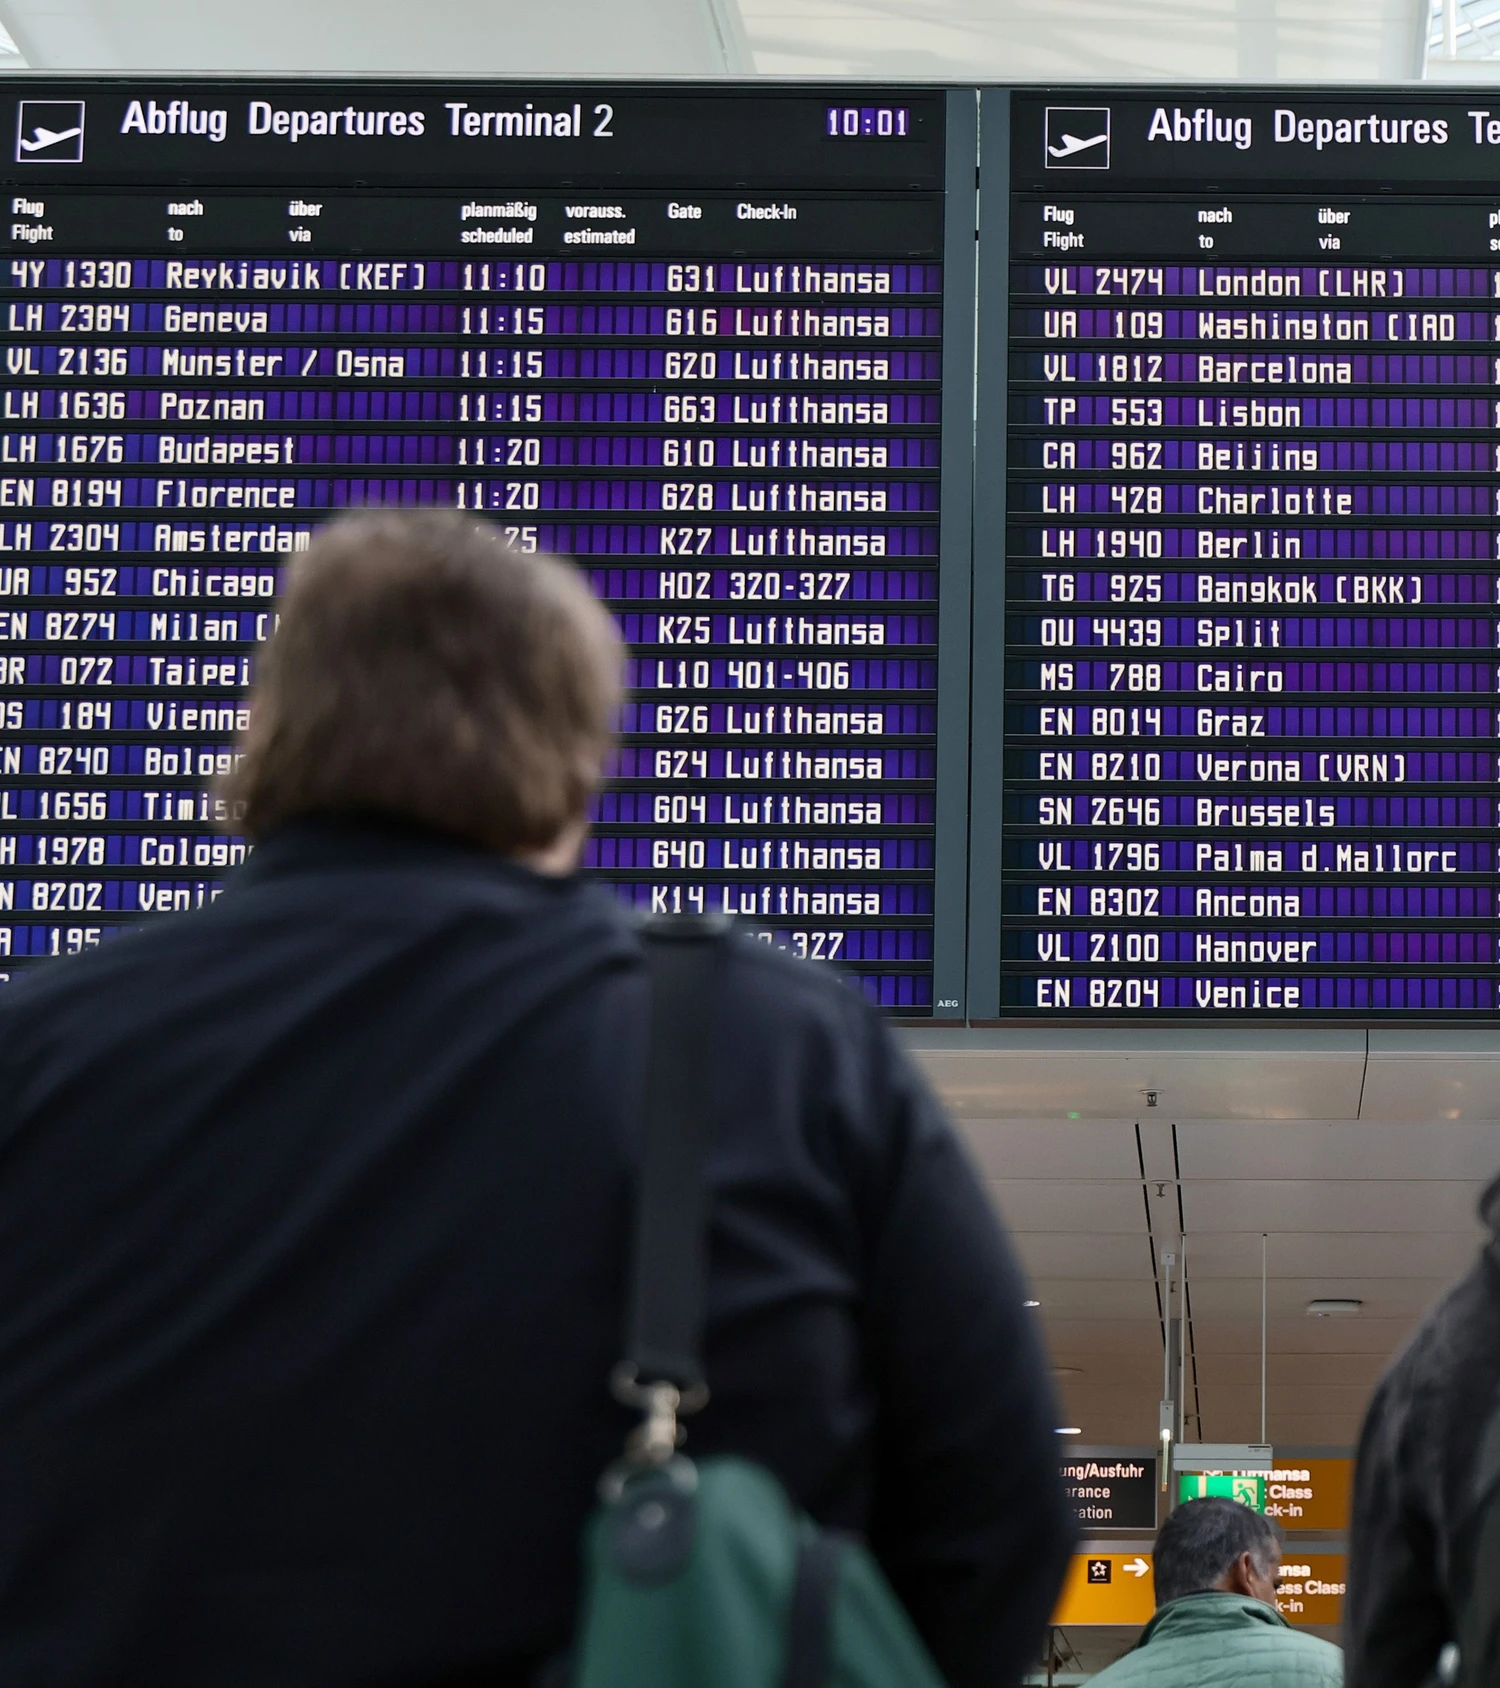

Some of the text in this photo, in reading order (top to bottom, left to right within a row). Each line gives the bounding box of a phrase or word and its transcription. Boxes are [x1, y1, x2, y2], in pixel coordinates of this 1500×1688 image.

[121, 100, 613, 143] Abflug Departures Terminal 2
[830, 109, 906, 136] 10:01
[1148, 107, 1252, 150] Abflug
[1274, 109, 1448, 151] Departures
[12, 197, 797, 222] Flug nach über planmäßig vorauss. Gate Check-In
[1043, 205, 1074, 226] Flug
[1198, 206, 1233, 223] nach
[1318, 207, 1350, 224] über
[12, 223, 636, 245] Flight to via scheduled estimated
[1043, 231, 1084, 251] Flight
[1198, 234, 1214, 249] to
[1318, 233, 1341, 250] via
[9, 304, 43, 332] LH
[61, 304, 130, 332] 2384
[165, 305, 268, 333] Geneva
[462, 307, 544, 335] 11:15
[736, 309, 889, 337] Lufthansa
[1044, 354, 1076, 382] VL
[1098, 355, 1162, 383] 1812
[1198, 355, 1351, 384] Barcelona
[4, 391, 39, 419] LH
[59, 391, 125, 420] 1636
[161, 392, 264, 421] Poznan
[460, 394, 542, 422] 11:15
[734, 396, 888, 424] Lufthansa
[2, 435, 36, 463] LH
[57, 435, 123, 463] 1676
[159, 436, 294, 464] Budapest
[459, 438, 540, 466] 11:20
[733, 440, 887, 468] Lufthansa
[1043, 442, 1076, 470] CA
[1112, 442, 1162, 470] 962
[1198, 442, 1318, 471] Beijing
[0, 479, 34, 507] EN
[52, 479, 122, 508] 8194
[157, 480, 295, 509] Florence
[457, 482, 539, 510] 11:20
[732, 483, 887, 512] Lufthansa
[1042, 485, 1075, 514] LH
[1111, 486, 1162, 514] 428
[1198, 486, 1352, 515] Charlotte
[65, 568, 851, 601] 952 Chicago H02 320-327
[1041, 618, 1074, 647] OU
[1093, 618, 1161, 647] 4439
[1197, 619, 1280, 648] Split
[61, 657, 849, 690] 072 Taipei L10 401-406
[1040, 707, 1073, 736] EN
[1092, 708, 1161, 736] 8014
[1197, 708, 1265, 737] Graz
[1037, 933, 1070, 962] VL
[1090, 933, 1159, 962] 2100
[1196, 934, 1317, 963] Hanover
[937, 999, 959, 1008] AEG
[1060, 1462, 1145, 1481] ung/Ausfuhr
[1269, 1484, 1313, 1499] Class
[1078, 1505, 1113, 1519] ation
[1264, 1503, 1303, 1517] ck-in
[1304, 1579, 1347, 1595] Class
